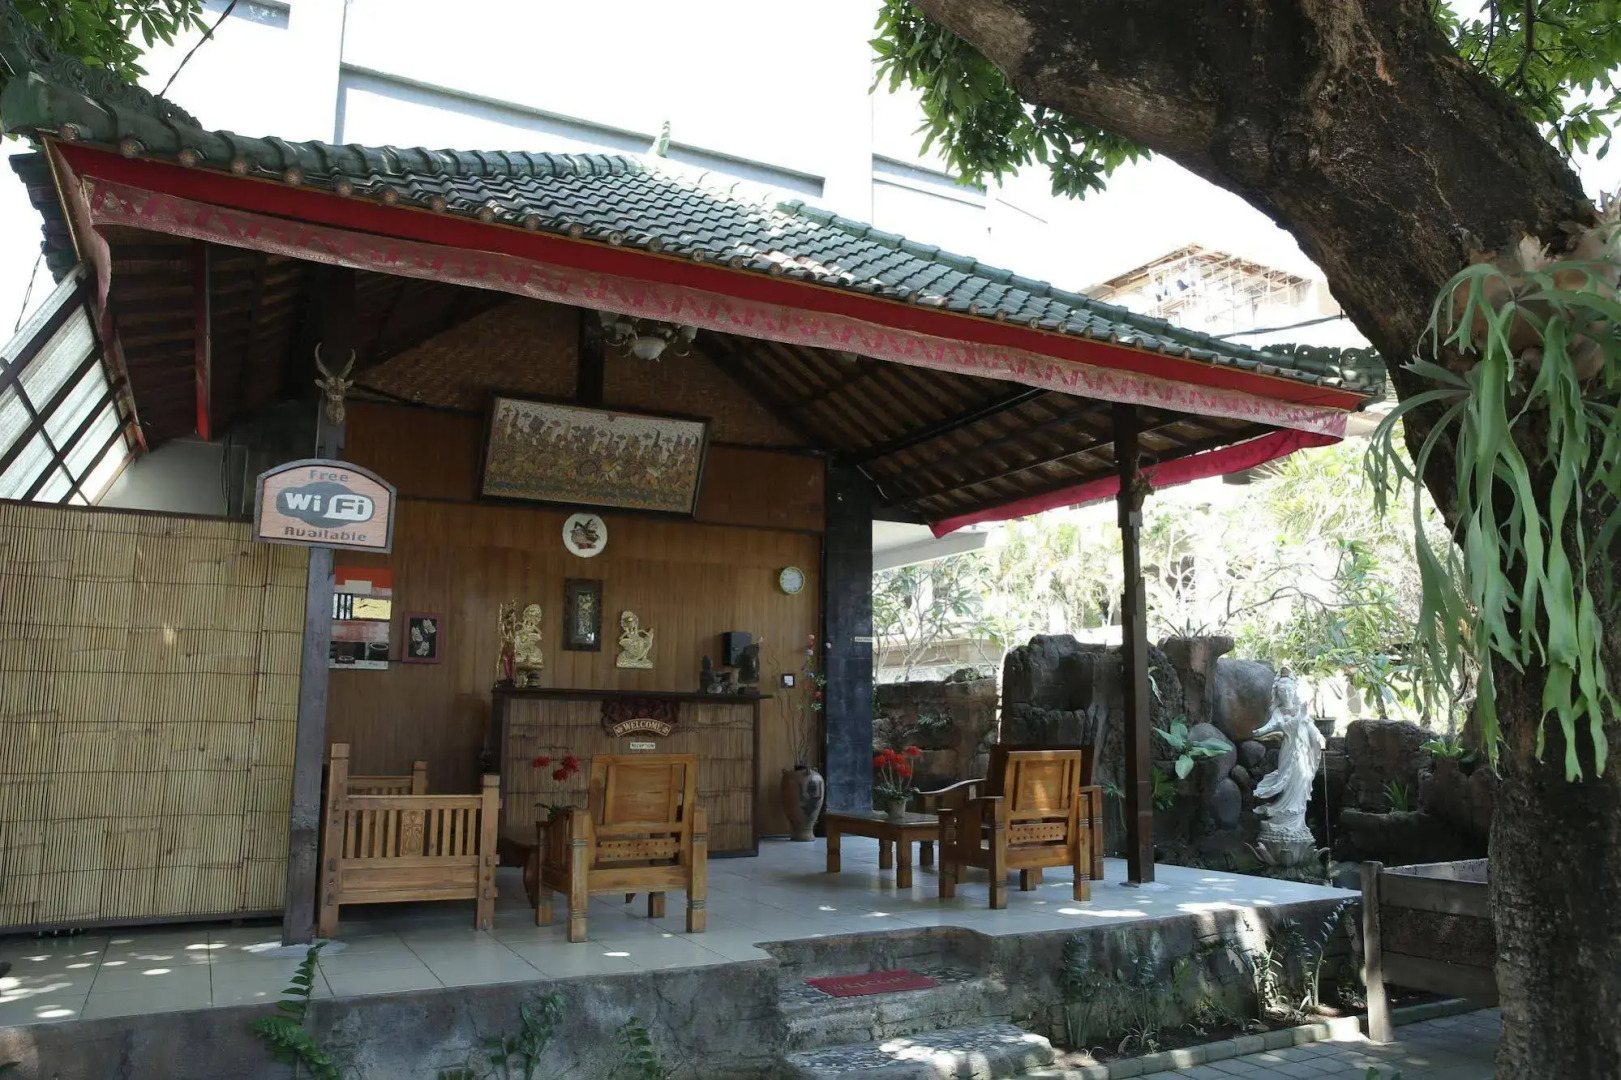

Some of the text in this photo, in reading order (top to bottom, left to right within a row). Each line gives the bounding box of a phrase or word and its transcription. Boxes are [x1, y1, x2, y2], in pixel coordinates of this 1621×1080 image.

[309, 469, 349, 482] Free
[284, 526, 368, 542] Available
[622, 720, 663, 732] WELCOME
